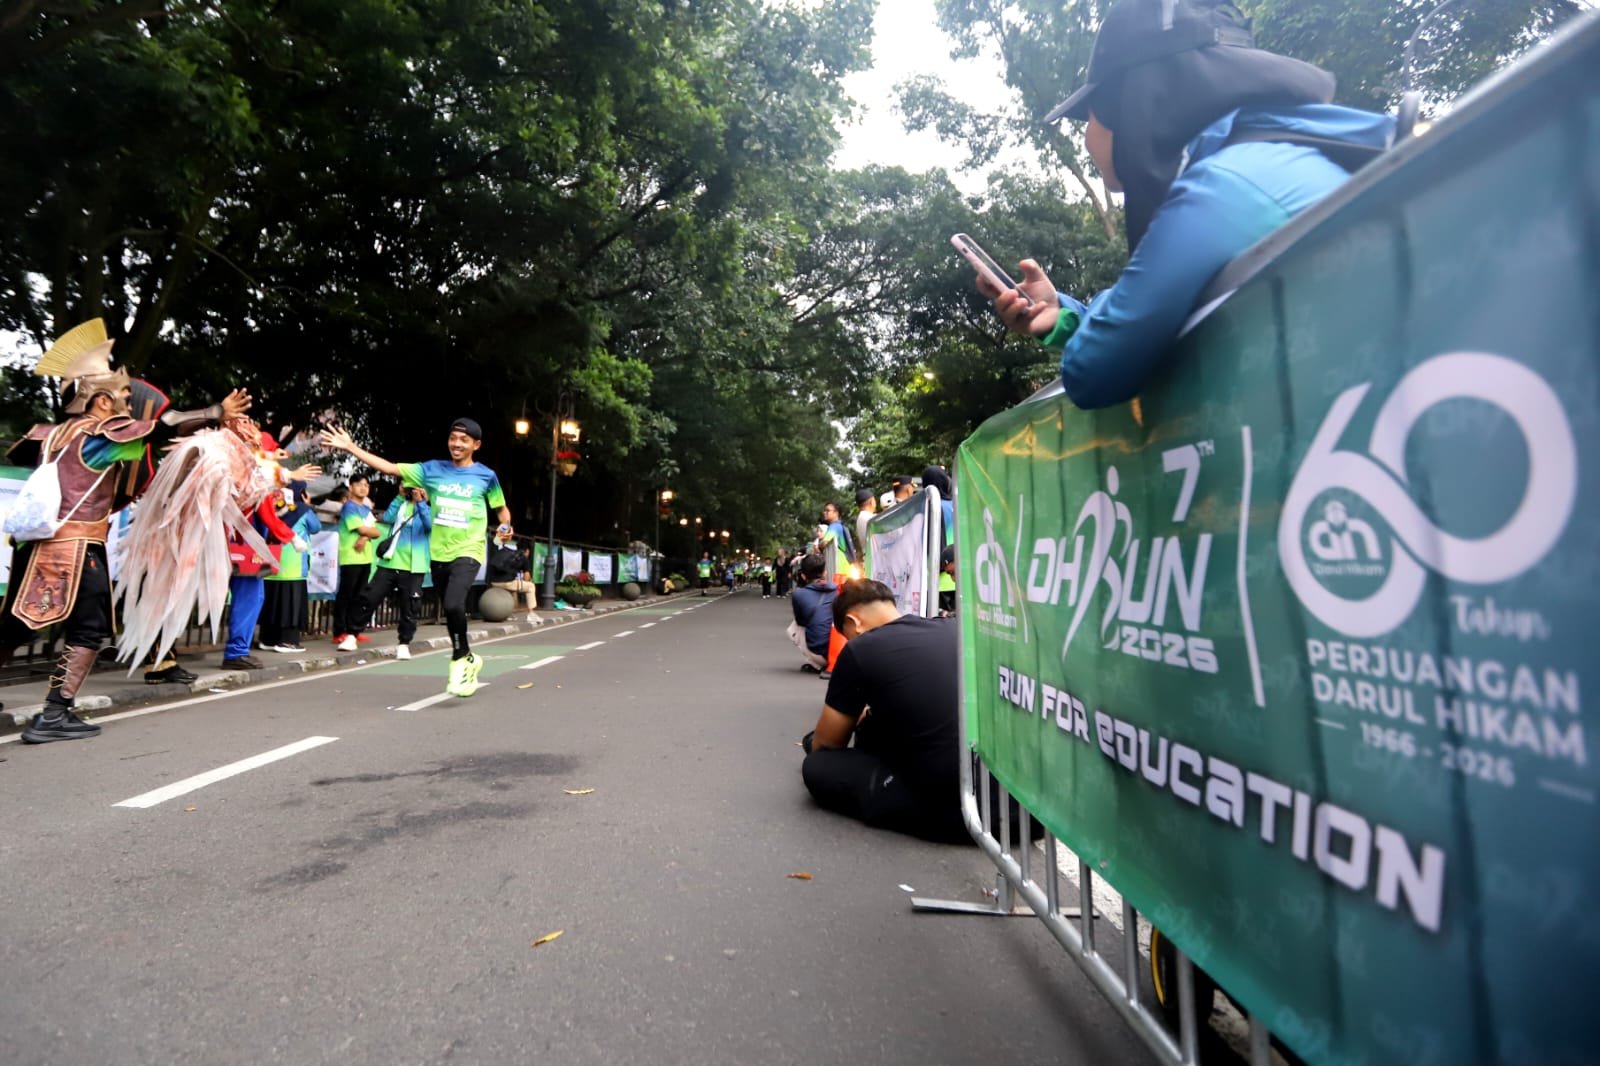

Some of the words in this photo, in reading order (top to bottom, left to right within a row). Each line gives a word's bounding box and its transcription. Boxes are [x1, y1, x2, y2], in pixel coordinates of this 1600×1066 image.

[1278, 351, 1578, 638] 60
[1121, 625, 1220, 674] 2026
[1306, 638, 1582, 713] PERJUANGAN
[999, 665, 1036, 713] RUN
[1041, 682, 1091, 744] FOR
[1311, 673, 1427, 727] DARUL
[1434, 695, 1586, 767] HIKAM
[1360, 719, 1416, 759] 1966
[1440, 742, 1517, 788] 2026
